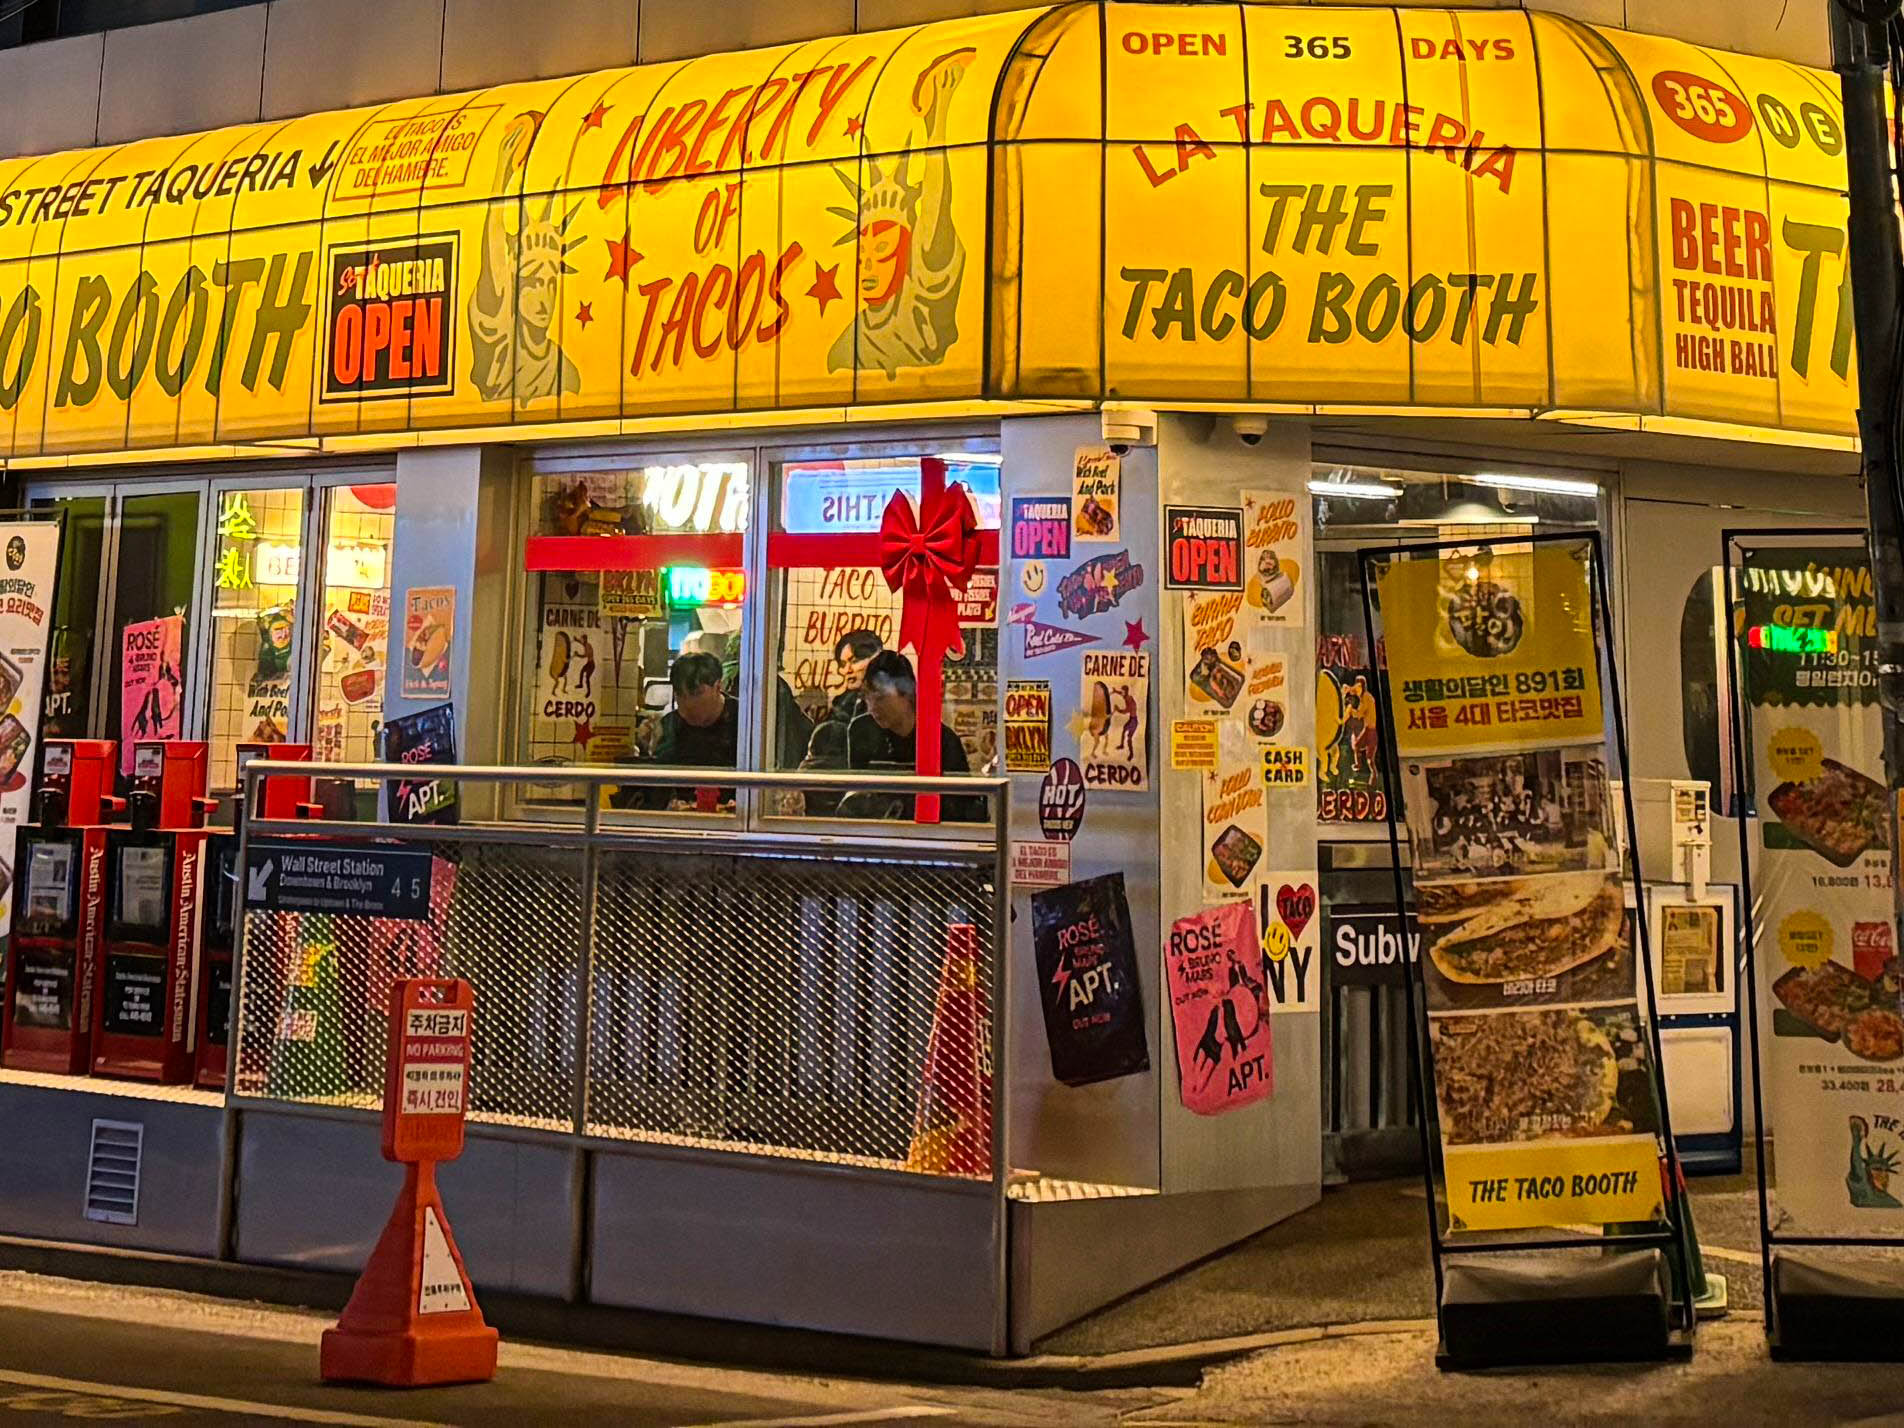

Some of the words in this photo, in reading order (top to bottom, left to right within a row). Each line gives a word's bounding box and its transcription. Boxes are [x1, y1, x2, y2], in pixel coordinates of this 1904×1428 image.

[1121, 32, 1227, 57] OPEN
[1283, 35, 1352, 60] 365
[1411, 38, 1515, 61] DAYS
[1673, 84, 1738, 127] 365
[367, 139, 423, 163] MEJOR
[421, 131, 476, 155] AMIGO
[598, 55, 876, 210] LIBERTY
[1132, 123, 1216, 188] LA
[1219, 96, 1519, 196] TAQUERIA
[124, 150, 302, 211] TAQUERIA
[694, 180, 746, 255] OF
[1259, 183, 1395, 258] THE
[1670, 198, 1772, 281] BEER
[355, 258, 444, 301] TAQUERIA
[631, 241, 803, 377] TACOS
[1120, 266, 1287, 342] TACO
[1307, 270, 1538, 345] BOOTH
[1672, 278, 1777, 334] TEQUILA
[54, 252, 315, 410] BOOTH
[334, 298, 442, 384] OPEN
[1675, 332, 1727, 374] HIGH
[1730, 336, 1779, 379] BALL
[1014, 521, 1067, 556] OPEN
[1182, 517, 1237, 539] TAQUERIA
[1173, 538, 1237, 584] OPEN
[546, 608, 584, 628] CARNE
[126, 625, 160, 651] ROSÉ
[1084, 655, 1126, 677] CARNE
[1129, 655, 1146, 678] DE
[1516, 666, 1585, 693] 891회
[544, 700, 596, 718] CERDO
[1005, 694, 1047, 717] OPEN
[1407, 705, 1449, 731] 서울
[1454, 702, 1491, 726] 4대
[1496, 695, 1584, 723] 타코맛집
[1084, 763, 1142, 785] CERDO
[1264, 751, 1303, 766] CASH
[1264, 769, 1304, 784] CARD
[408, 780, 445, 820] APT.
[1043, 783, 1080, 806] HOT
[281, 855, 306, 873] Wall
[307, 857, 342, 874] Street
[343, 858, 384, 877] Station
[391, 877, 401, 898] 4
[411, 878, 421, 899] 5
[1282, 895, 1314, 920] TACO
[1058, 914, 1099, 951] ROSÉ
[1170, 917, 1223, 957] ROSÉ
[1068, 962, 1120, 1012] APT.
[1263, 945, 1313, 1004] NY
[409, 1013, 465, 1035] 주차금지
[406, 1043, 421, 1058] NO
[423, 1043, 464, 1058] PARKING
[1226, 1056, 1270, 1097] APT.
[1468, 1178, 1508, 1204] THE
[1514, 1175, 1564, 1201] TACO
[1571, 1171, 1637, 1197] BOOTH
